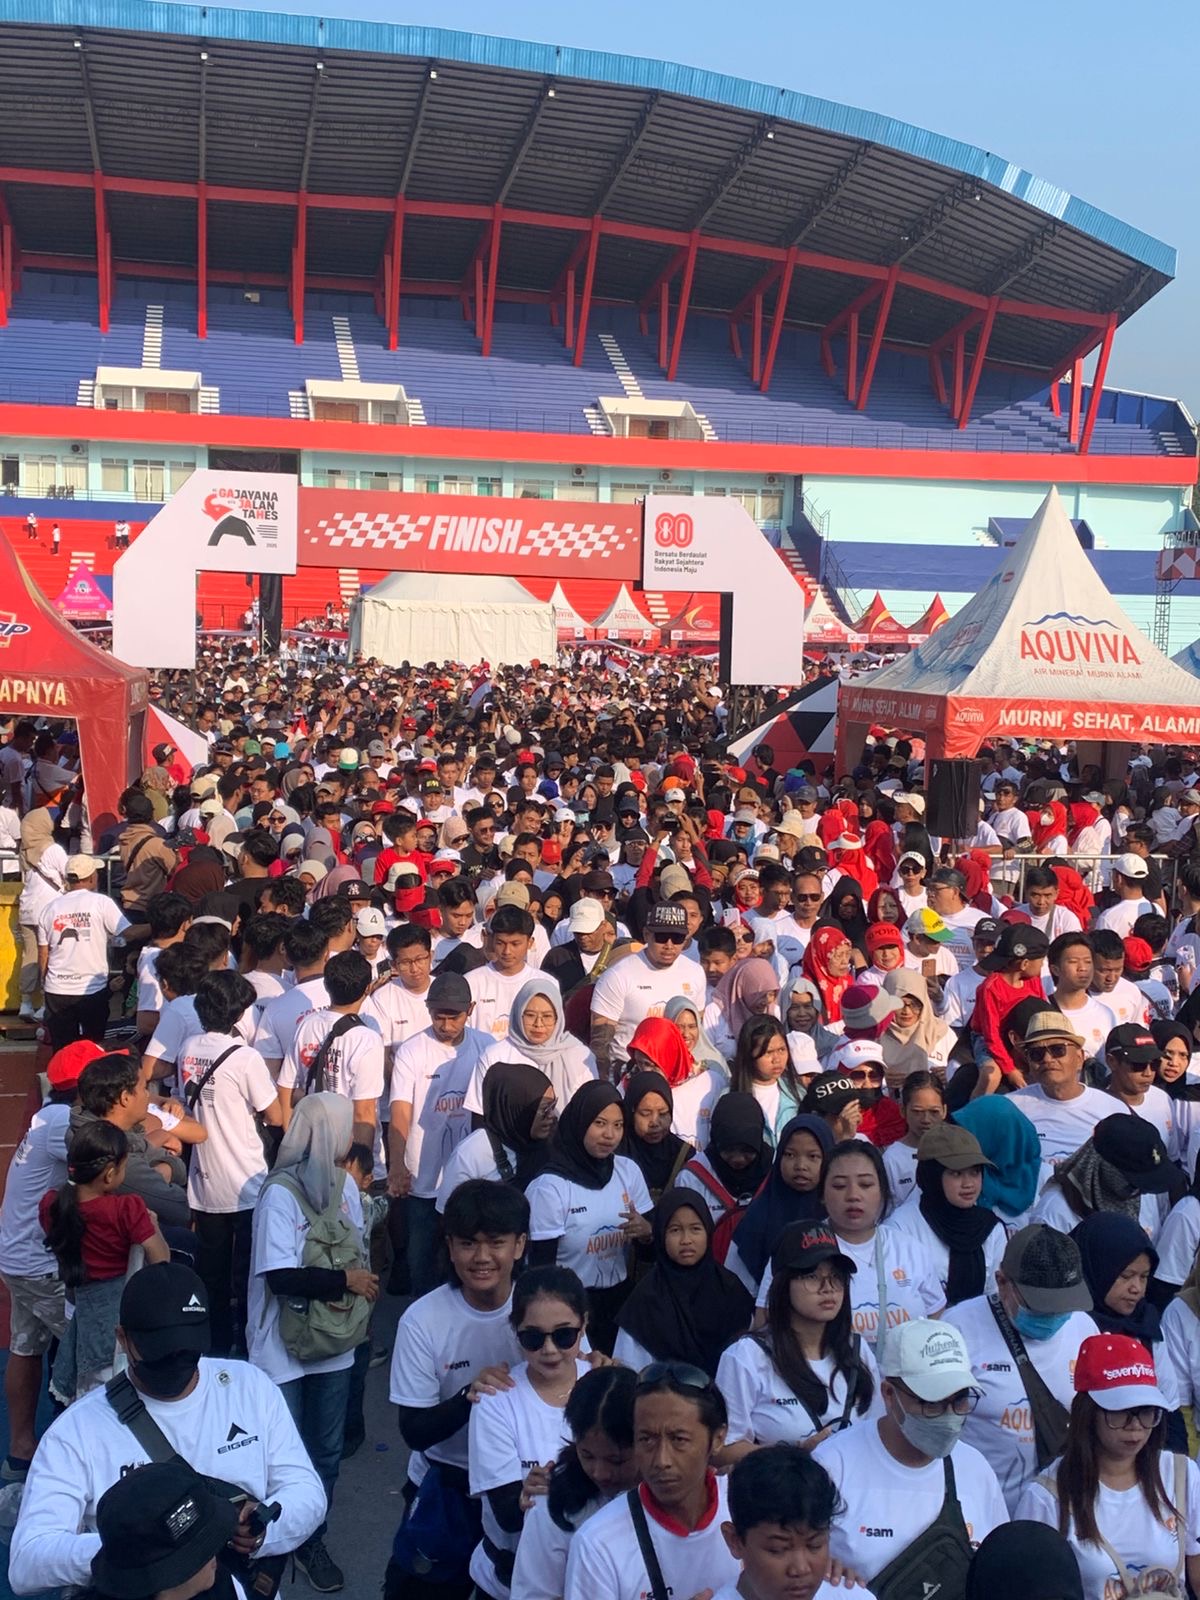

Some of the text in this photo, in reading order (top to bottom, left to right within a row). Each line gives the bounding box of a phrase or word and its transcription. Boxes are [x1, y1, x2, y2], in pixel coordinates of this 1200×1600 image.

[219, 488, 278, 501] GAJAYANA
[239, 500, 275, 510] JALAN
[242, 509, 278, 520] TAHES
[428, 515, 523, 553] FINISH
[655, 512, 693, 548] 80
[654, 558, 704, 567] Rakyat Sejahtera
[1020, 629, 1142, 665] AQUVIVA
[998, 708, 1066, 731] MURNI,
[1072, 712, 1135, 734] SEHAT,
[370, 914, 378, 924] 4
[217, 1436, 259, 1454] EIGER
[860, 1526, 893, 1537] #sam
